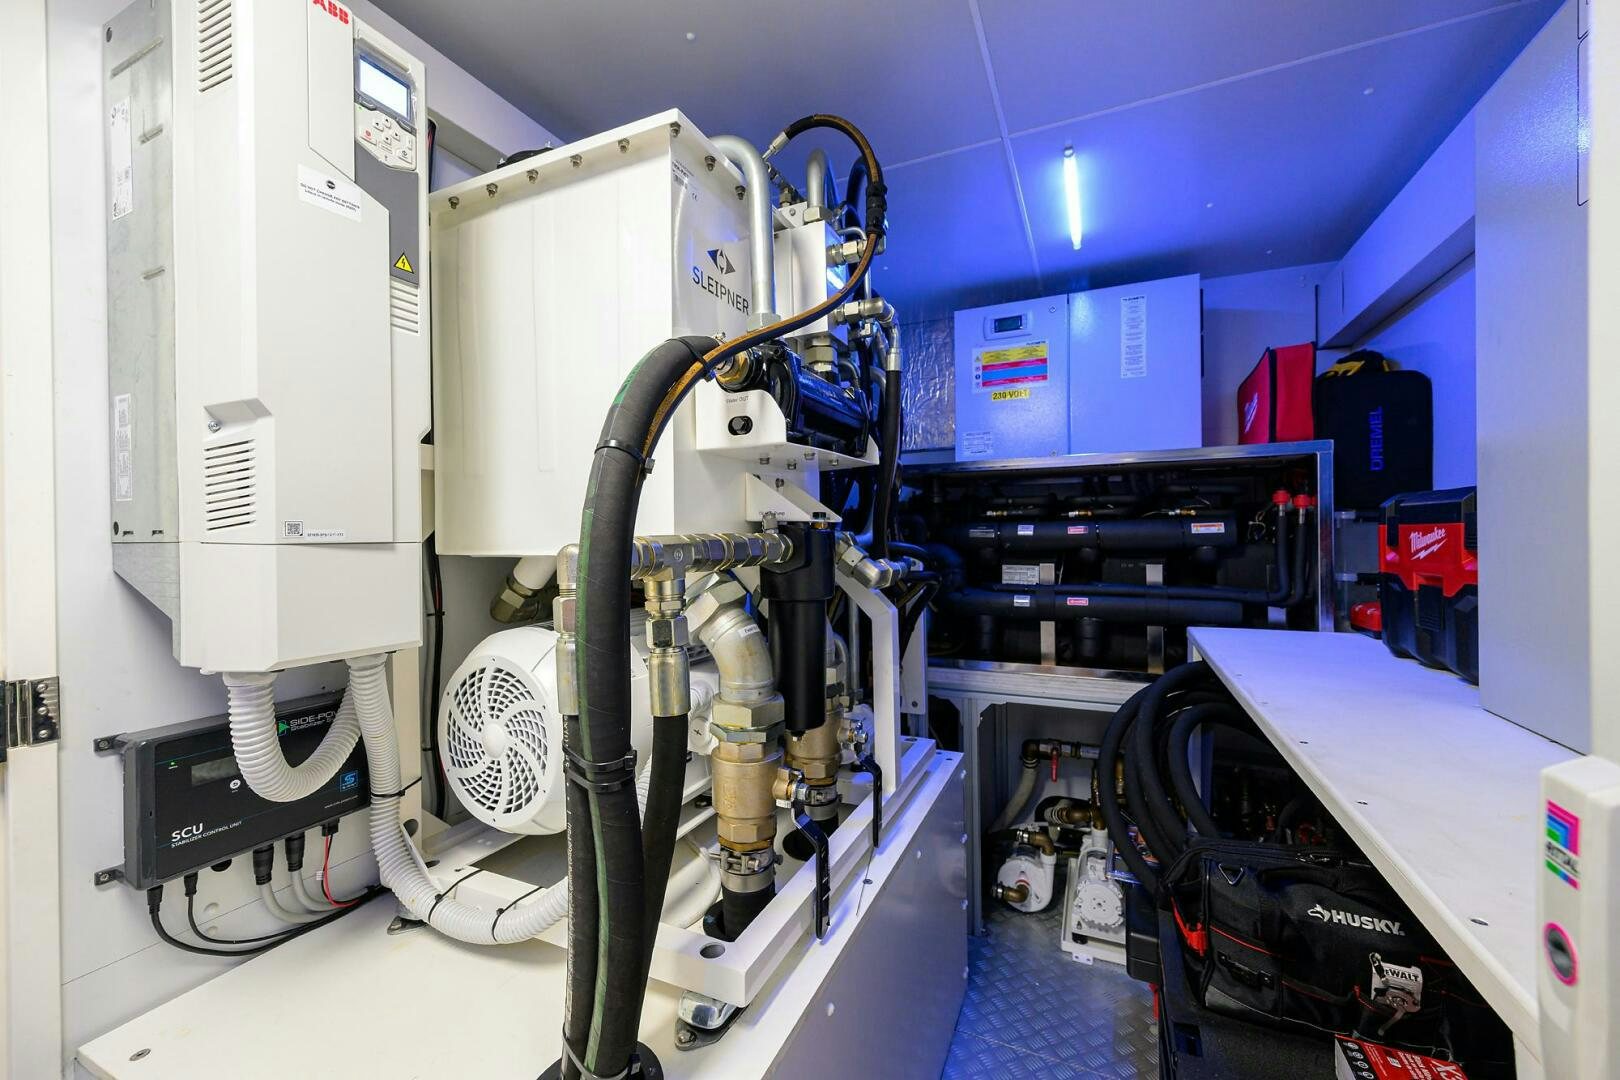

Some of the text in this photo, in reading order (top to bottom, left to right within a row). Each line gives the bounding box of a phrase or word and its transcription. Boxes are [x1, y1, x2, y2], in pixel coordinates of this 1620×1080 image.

[313, 0, 349, 24] ABB
[692, 266, 750, 316] SLEIPNER
[992, 389, 1028, 400] 230 VOLT
[1369, 406, 1383, 470] DREMEL
[1410, 526, 1446, 553] Milwaukee
[171, 822, 204, 842] SCU
[203, 825, 229, 837] CONTROL
[229, 820, 242, 829] UNIT
[1331, 909, 1401, 936] HUSKY
